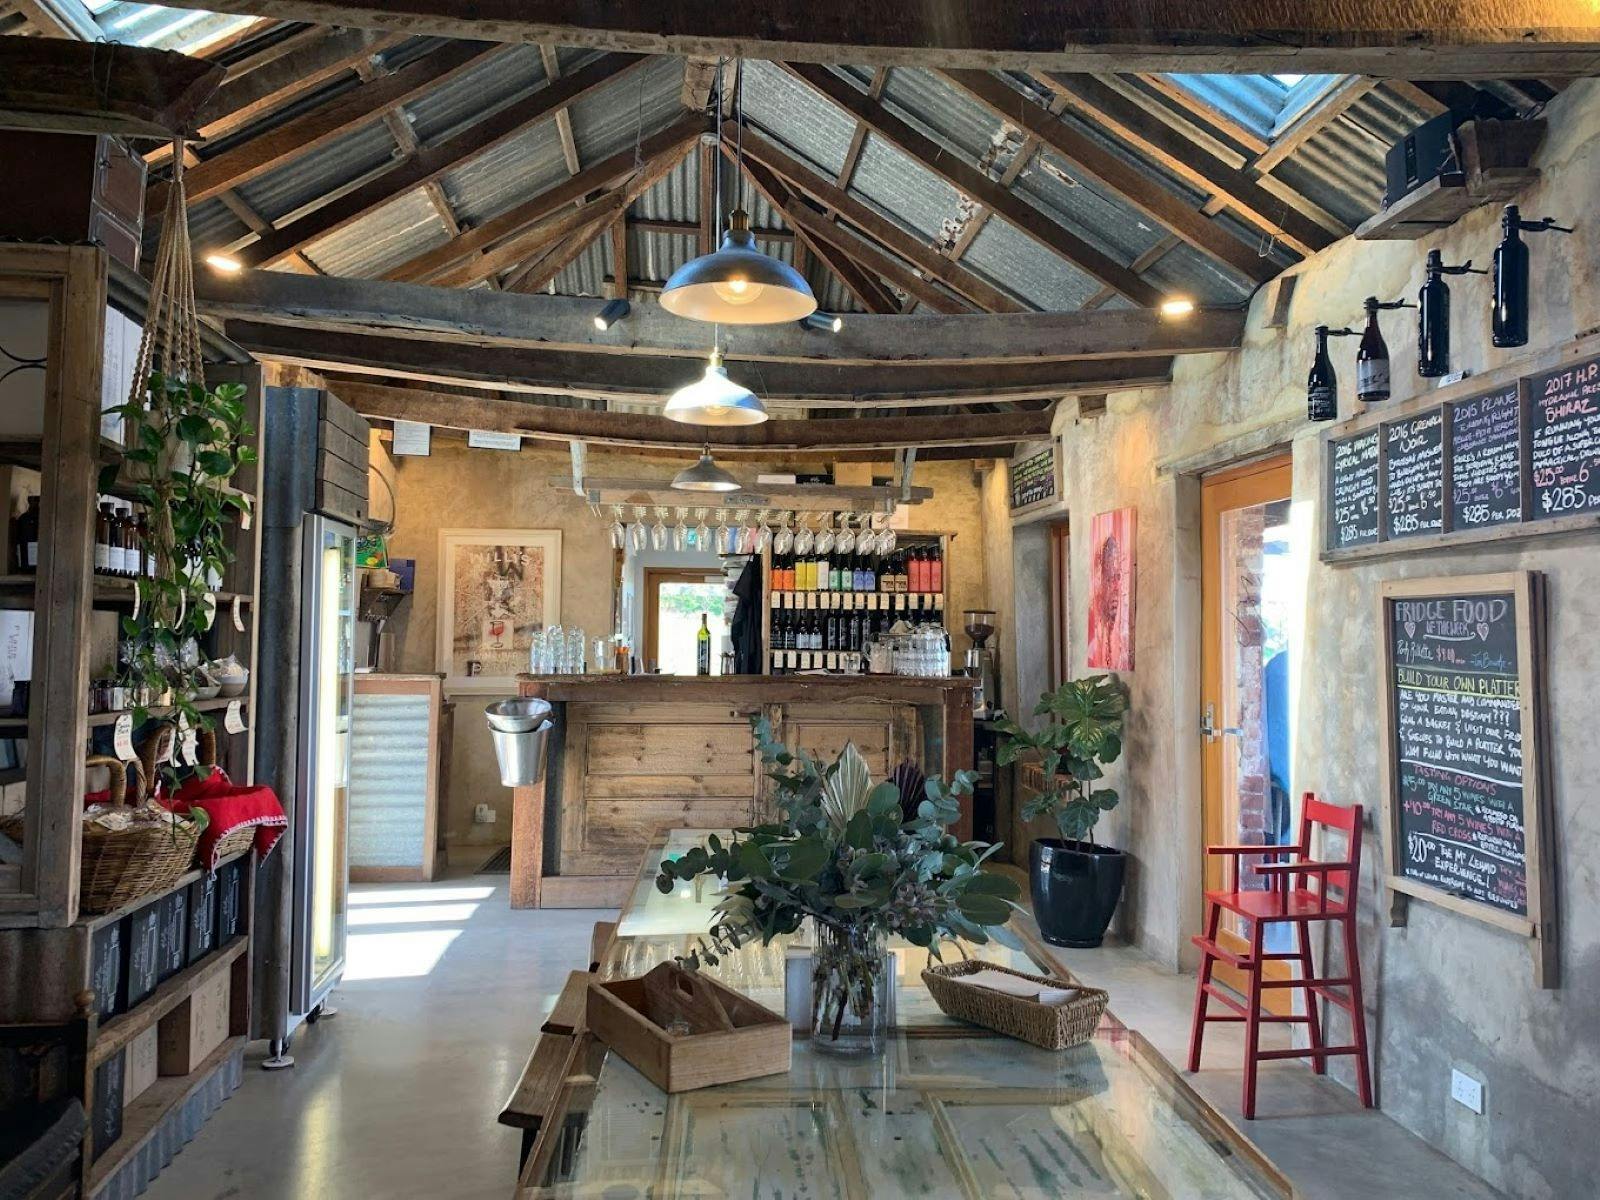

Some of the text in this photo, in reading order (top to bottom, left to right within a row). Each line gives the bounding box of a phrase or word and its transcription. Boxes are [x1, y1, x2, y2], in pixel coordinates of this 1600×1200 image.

[1545, 372, 1572, 395] 2017
[1545, 398, 1598, 423] SHIRAZ
[1388, 424, 1408, 442] 2016
[1541, 485, 1587, 513] $285
[1393, 513, 1420, 535] $285
[1462, 504, 1490, 523] $285
[1396, 599, 1508, 623] FRIDGE FOOD
[1398, 668, 1422, 686] BUILD
[1424, 673, 1450, 690] YOUR
[1454, 676, 1475, 692] OWN
[1453, 787, 1462, 801] 5
[1455, 775, 1497, 796] OPTIONS
[1432, 820, 1472, 842] RED CROSS
[1458, 815, 1465, 826] 5
